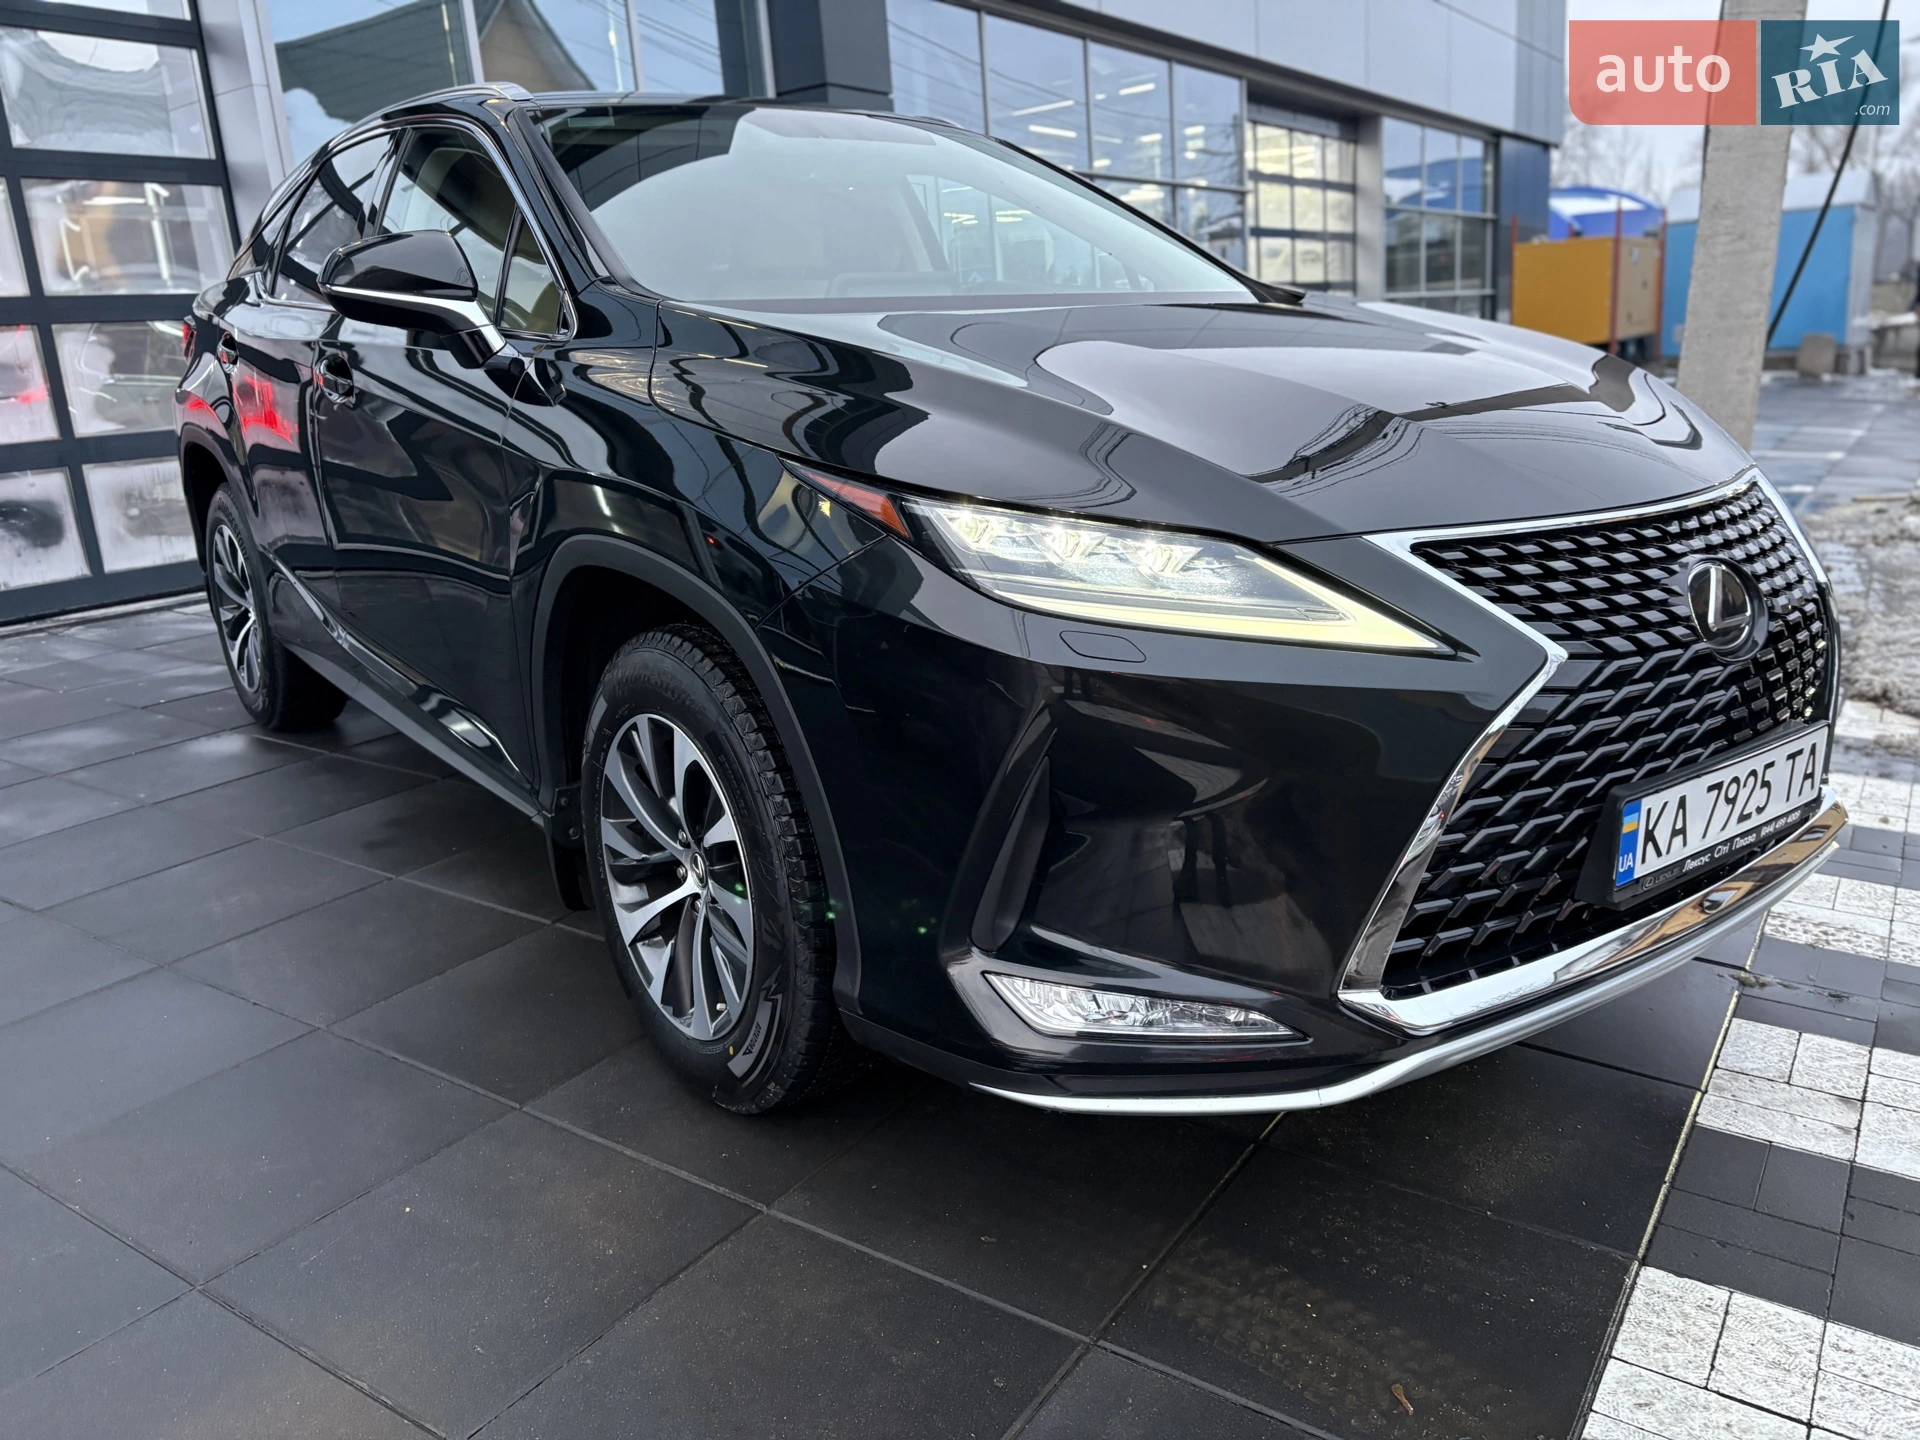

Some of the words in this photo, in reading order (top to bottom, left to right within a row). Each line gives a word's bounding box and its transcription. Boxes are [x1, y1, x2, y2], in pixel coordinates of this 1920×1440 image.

[1641, 794, 1688, 865] KA
[1700, 760, 1776, 840] 7925
[1785, 742, 1818, 803] TA
[1618, 853, 1634, 873] UA
